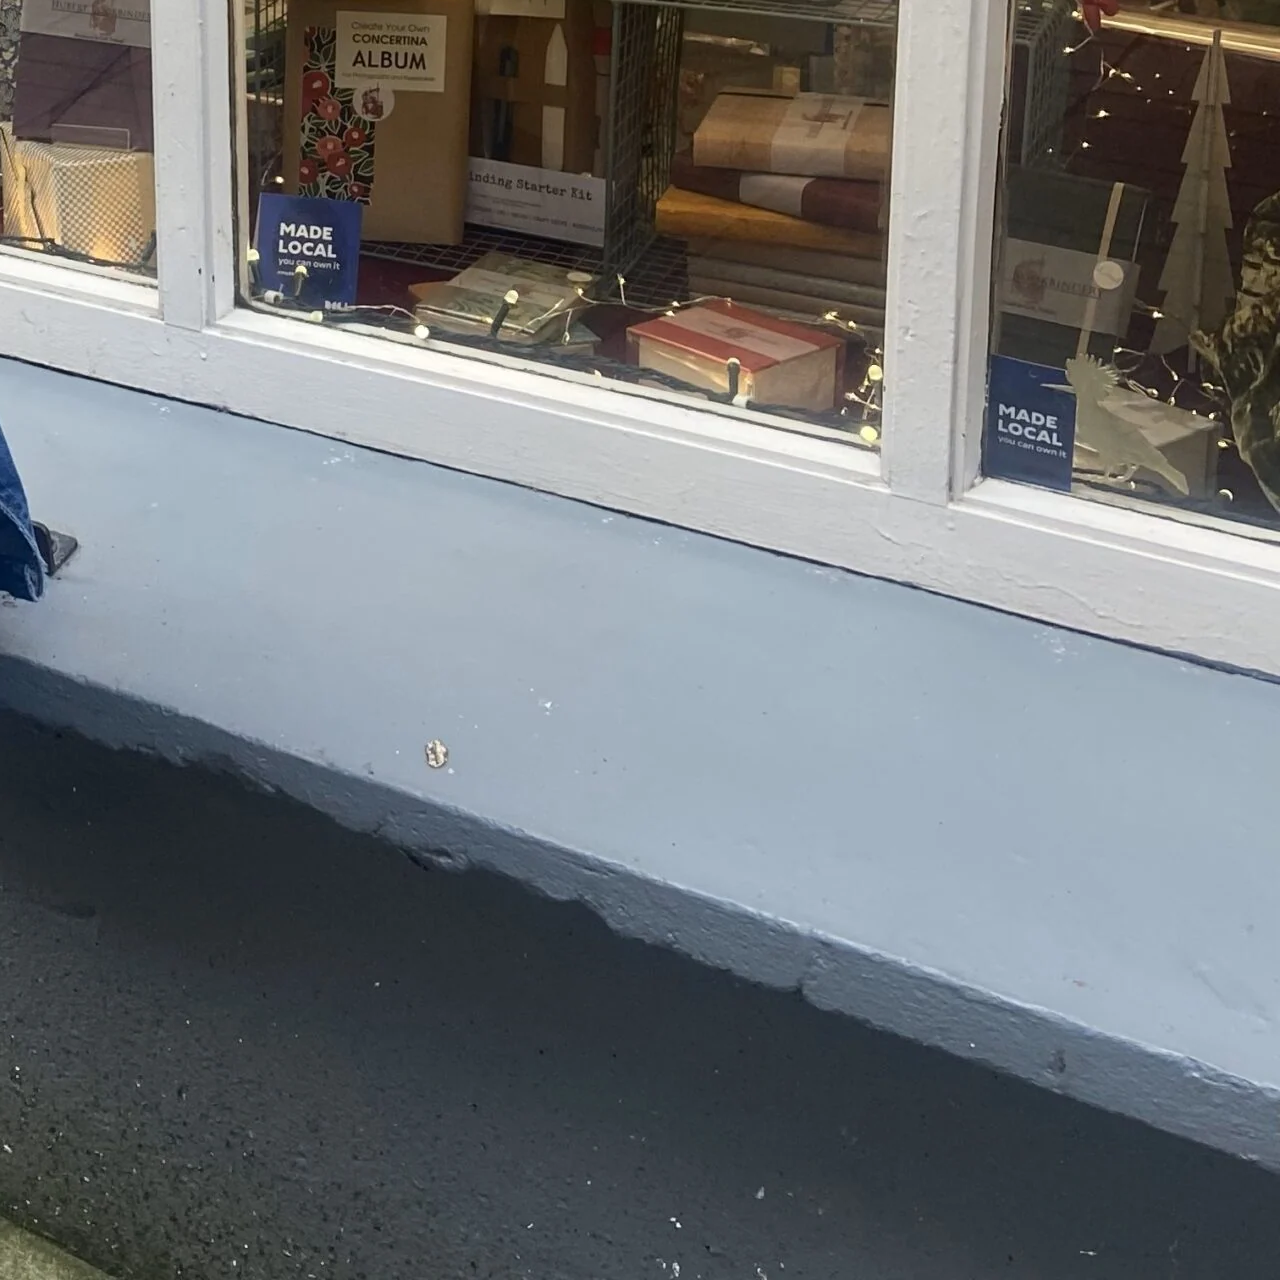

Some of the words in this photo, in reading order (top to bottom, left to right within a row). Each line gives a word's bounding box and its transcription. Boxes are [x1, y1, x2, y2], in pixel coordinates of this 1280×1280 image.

[351, 21, 383, 31] Create
[386, 23, 406, 32] Your
[407, 24, 431, 33] Own
[352, 33, 428, 47] CONCERTINA
[352, 49, 426, 70] ALBUM
[516, 179, 567, 197] Starter
[571, 187, 593, 201] Kit
[280, 222, 333, 240] MADE
[278, 240, 337, 258] LOCAL
[278, 258, 295, 267] you
[296, 259, 312, 268] can
[313, 261, 332, 269] own
[333, 261, 341, 270] it
[999, 403, 1058, 429] MADE
[998, 419, 1063, 447] LOCAL
[998, 436, 1016, 445] you
[1017, 441, 1034, 450] can
[1036, 446, 1057, 456] own
[1058, 449, 1067, 459] it
